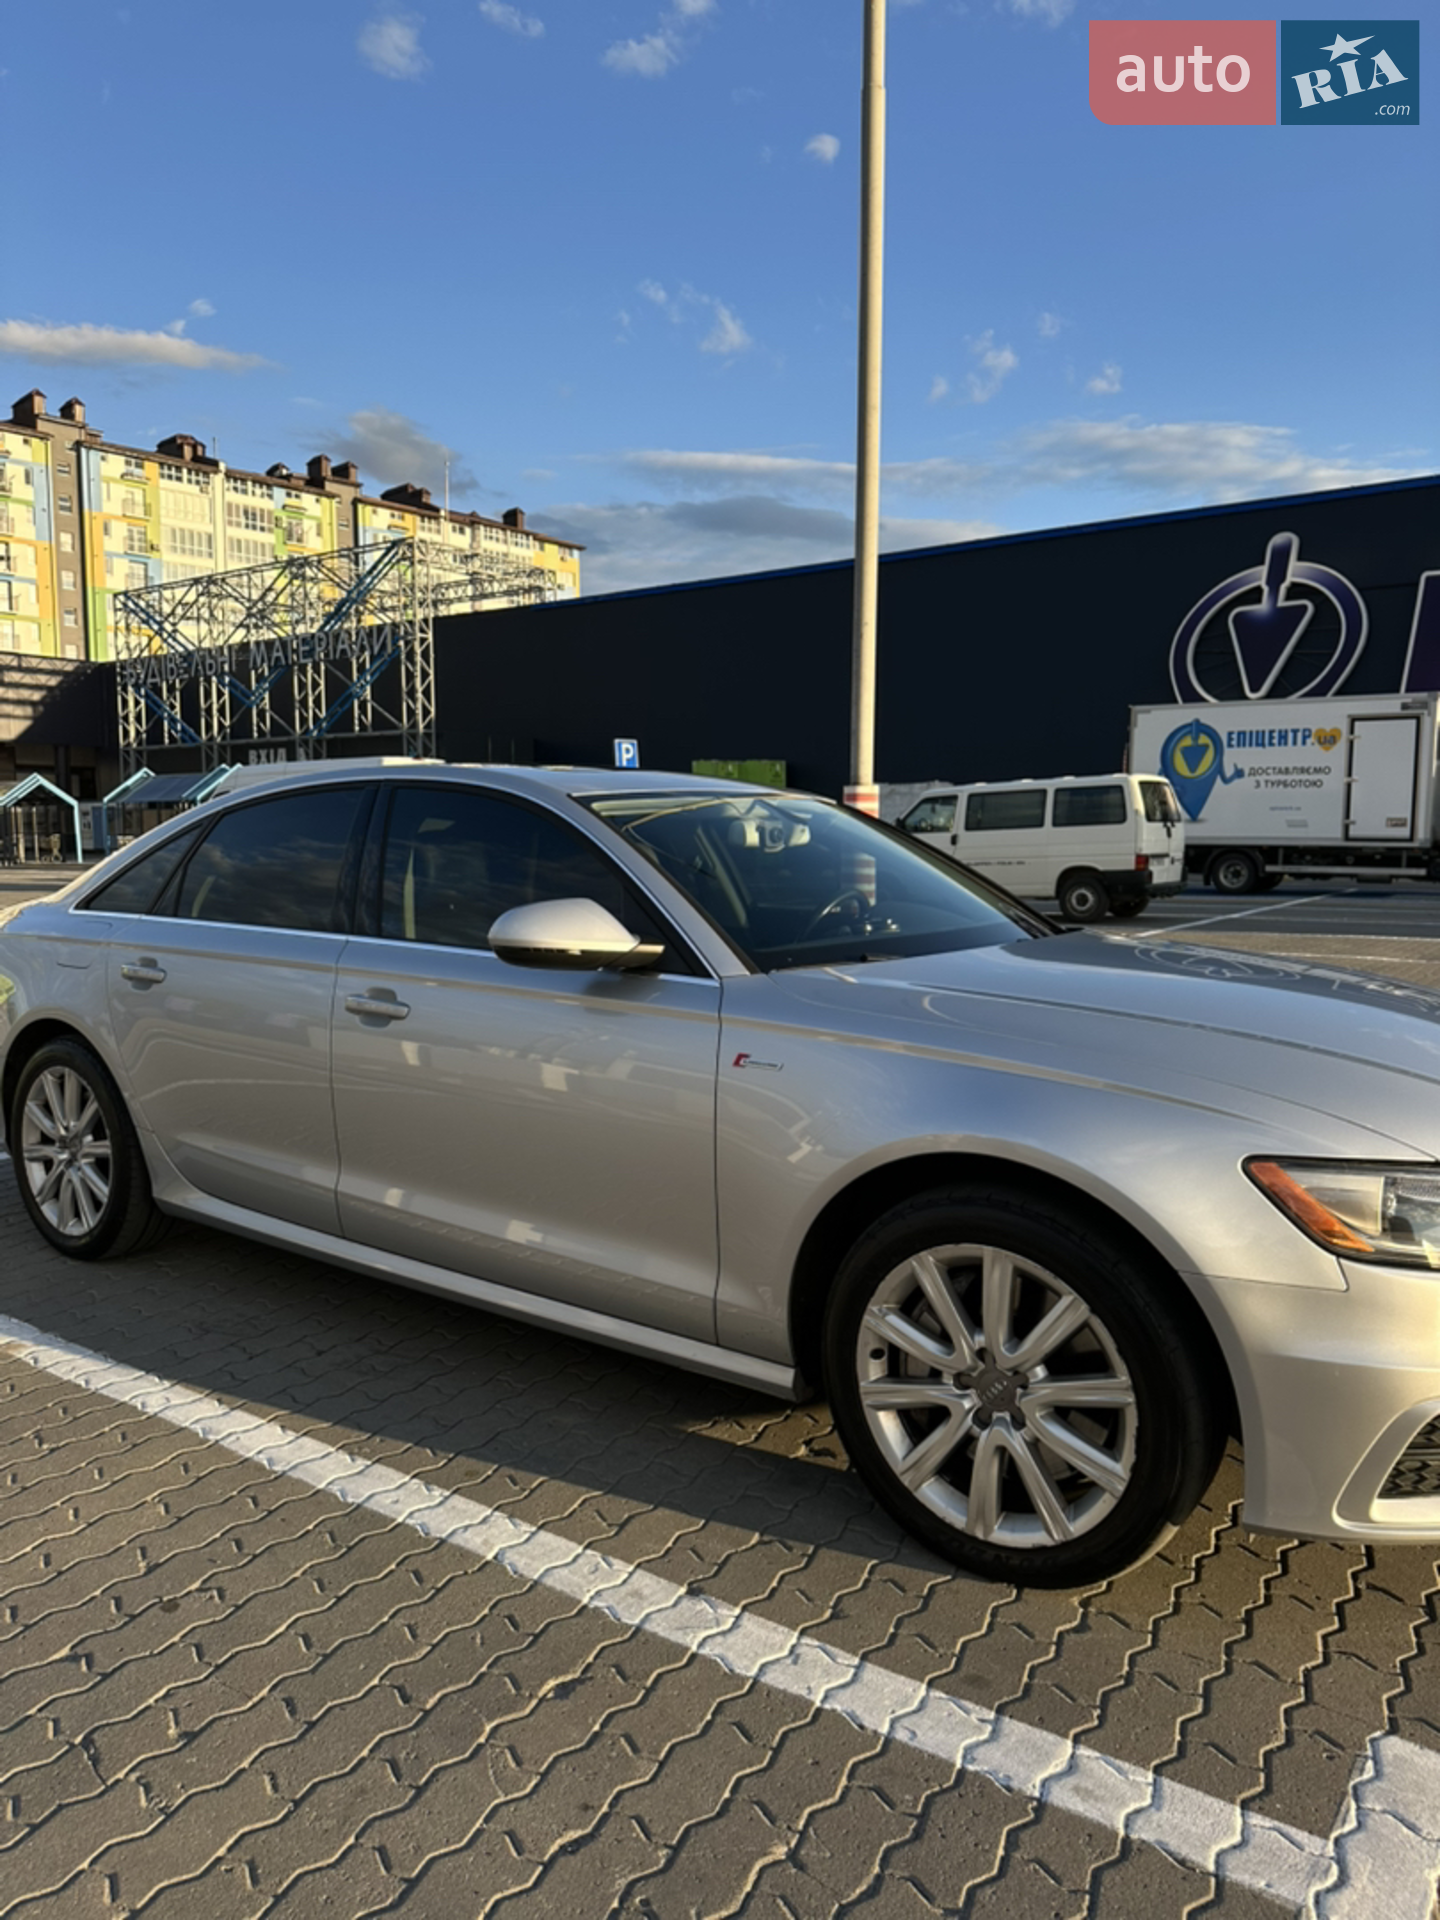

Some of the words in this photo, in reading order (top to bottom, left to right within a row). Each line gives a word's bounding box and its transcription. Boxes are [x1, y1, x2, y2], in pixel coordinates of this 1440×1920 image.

[124, 647, 236, 688] БУДІВЕЛЬНІ
[249, 623, 392, 669] МАТЕРІАЛИ
[622, 743, 634, 767] P
[1248, 765, 1332, 777] ДОСТАВЛЯЄМО
[1264, 778, 1323, 789] ТУРБОТОЮ
